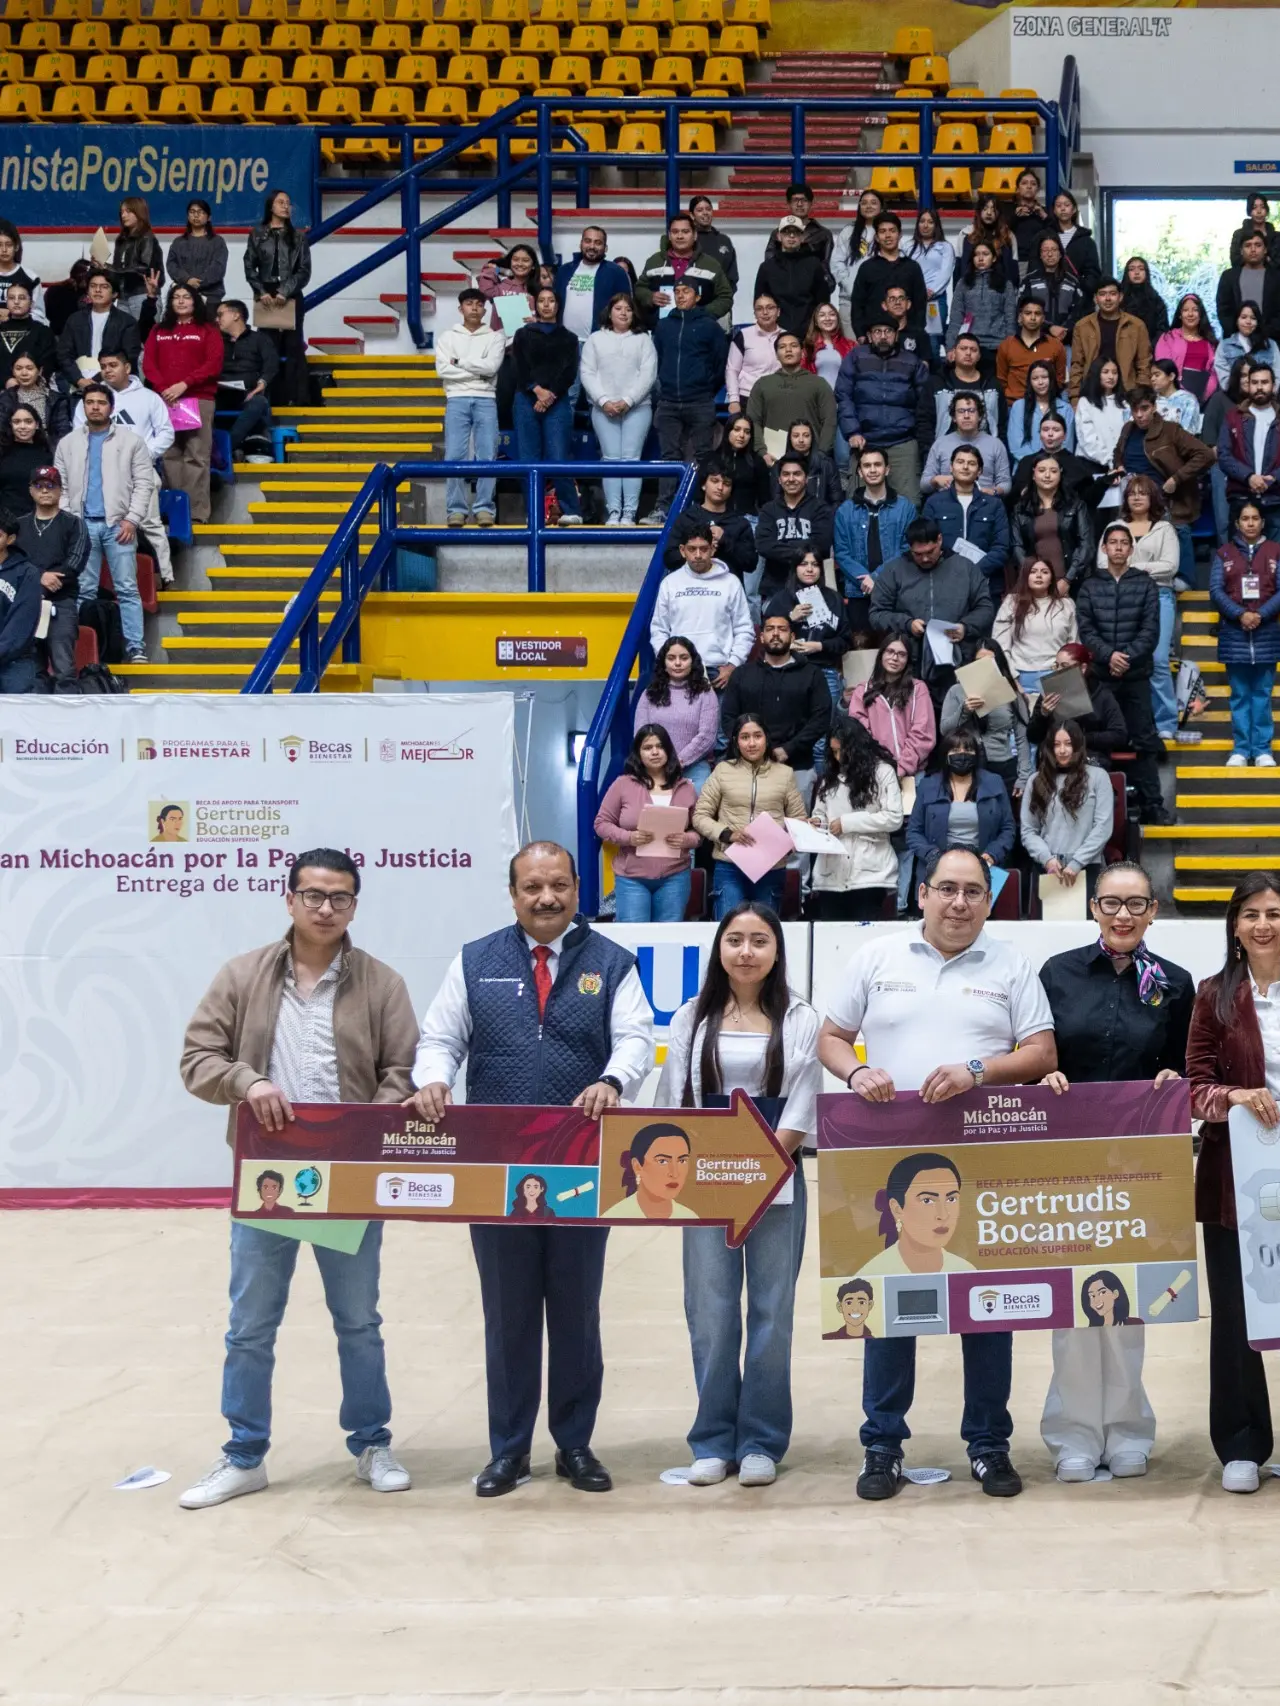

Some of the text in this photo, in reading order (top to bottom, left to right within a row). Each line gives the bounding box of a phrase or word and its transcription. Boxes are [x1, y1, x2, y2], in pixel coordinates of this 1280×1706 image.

[1014, 16, 1063, 36] ZONA
[1245, 163, 1277, 171] SALIDA
[776, 517, 812, 540] GAP
[516, 641, 562, 650] VESTIDOR
[516, 652, 546, 661] LOCAL
[15, 739, 110, 754] Educación
[163, 748, 250, 758] BIENESTAR
[309, 740, 352, 753] Becas
[196, 806, 281, 821] Gertrudis
[196, 822, 290, 840] Bocanegra
[40, 847, 174, 869] Michoacán
[184, 853, 227, 872] por
[237, 848, 258, 869] la
[268, 849, 297, 868] Pa
[375, 848, 472, 868] Justicia
[116, 874, 239, 897] Entrega de
[988, 1095, 1022, 1109] Plan
[963, 1106, 1047, 1124] Michoacán
[405, 1120, 436, 1133] Plan
[964, 1128, 976, 1136] por
[978, 1126, 986, 1134] la
[988, 1126, 1000, 1134] Paz
[1018, 1124, 1047, 1132] Justicia
[382, 1133, 456, 1146] Michoacán
[430, 1148, 456, 1156] Justicia
[696, 1158, 760, 1170] Gertrudis
[696, 1170, 767, 1184] Bocanegra
[976, 1172, 1162, 1188] BECA DE APOYO PARA TRANSPORTE
[408, 1182, 442, 1192] Becas
[976, 1185, 1130, 1217] Gertrudis
[978, 1216, 1146, 1248] Bocanegra
[978, 1242, 1092, 1257] EDUCACIÓN SUPERIOR
[1003, 1292, 1040, 1304] Becas
